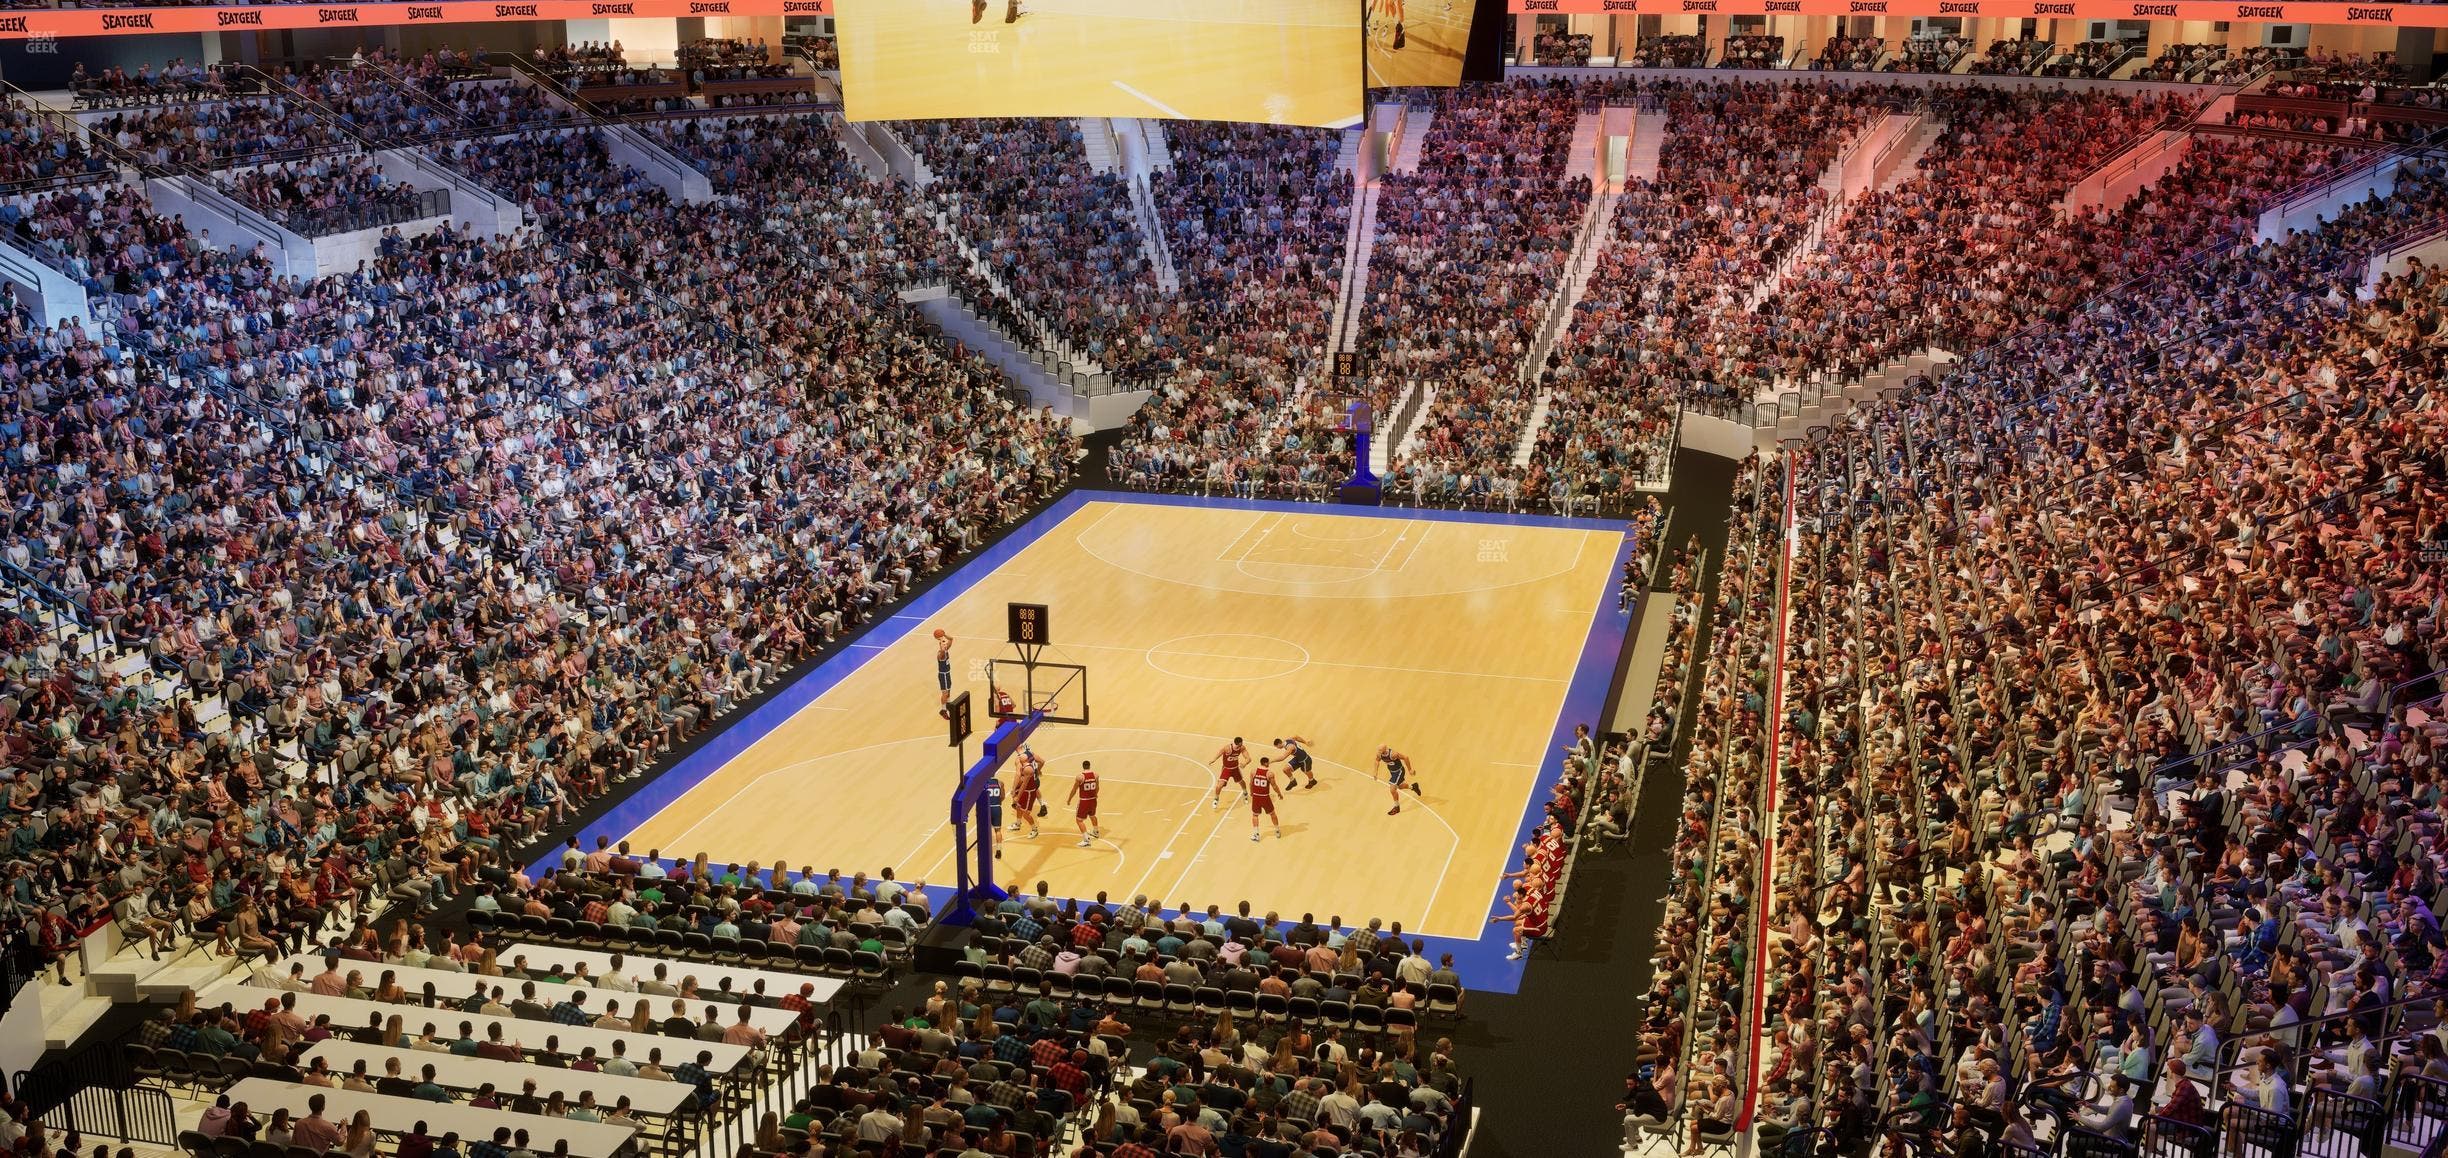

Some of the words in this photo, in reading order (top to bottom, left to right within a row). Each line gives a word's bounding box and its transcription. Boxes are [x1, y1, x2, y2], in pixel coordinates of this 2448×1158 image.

[407, 6, 443, 19] SEATGEEK
[495, 5, 537, 17] SEATGEEK
[592, 2, 635, 15] SEATGEEK
[690, 1, 730, 14] SEATGEEK
[783, 1, 823, 13] SEATGEEK
[1524, 1, 1559, 11] SEATGEEK
[1603, 1, 1637, 11] SEATGEEK
[1683, 0, 1718, 12] SEATGEEK
[1764, 1, 1801, 13] SEATGEEK
[1849, 1, 1888, 14] SEATGEEK
[1939, 1, 1979, 14] SEATGEEK
[2033, 2, 2076, 15] SEATGEEK
[2132, 3, 2178, 18] SEATGEEK
[2236, 5, 2284, 20] SEATGEEK
[102, 13, 154, 30] SEATGEEK
[218, 11, 263, 26] SEATGEEK
[318, 8, 359, 23] SEATGEEK
[2346, 7, 2394, 23] SEATGEEK
